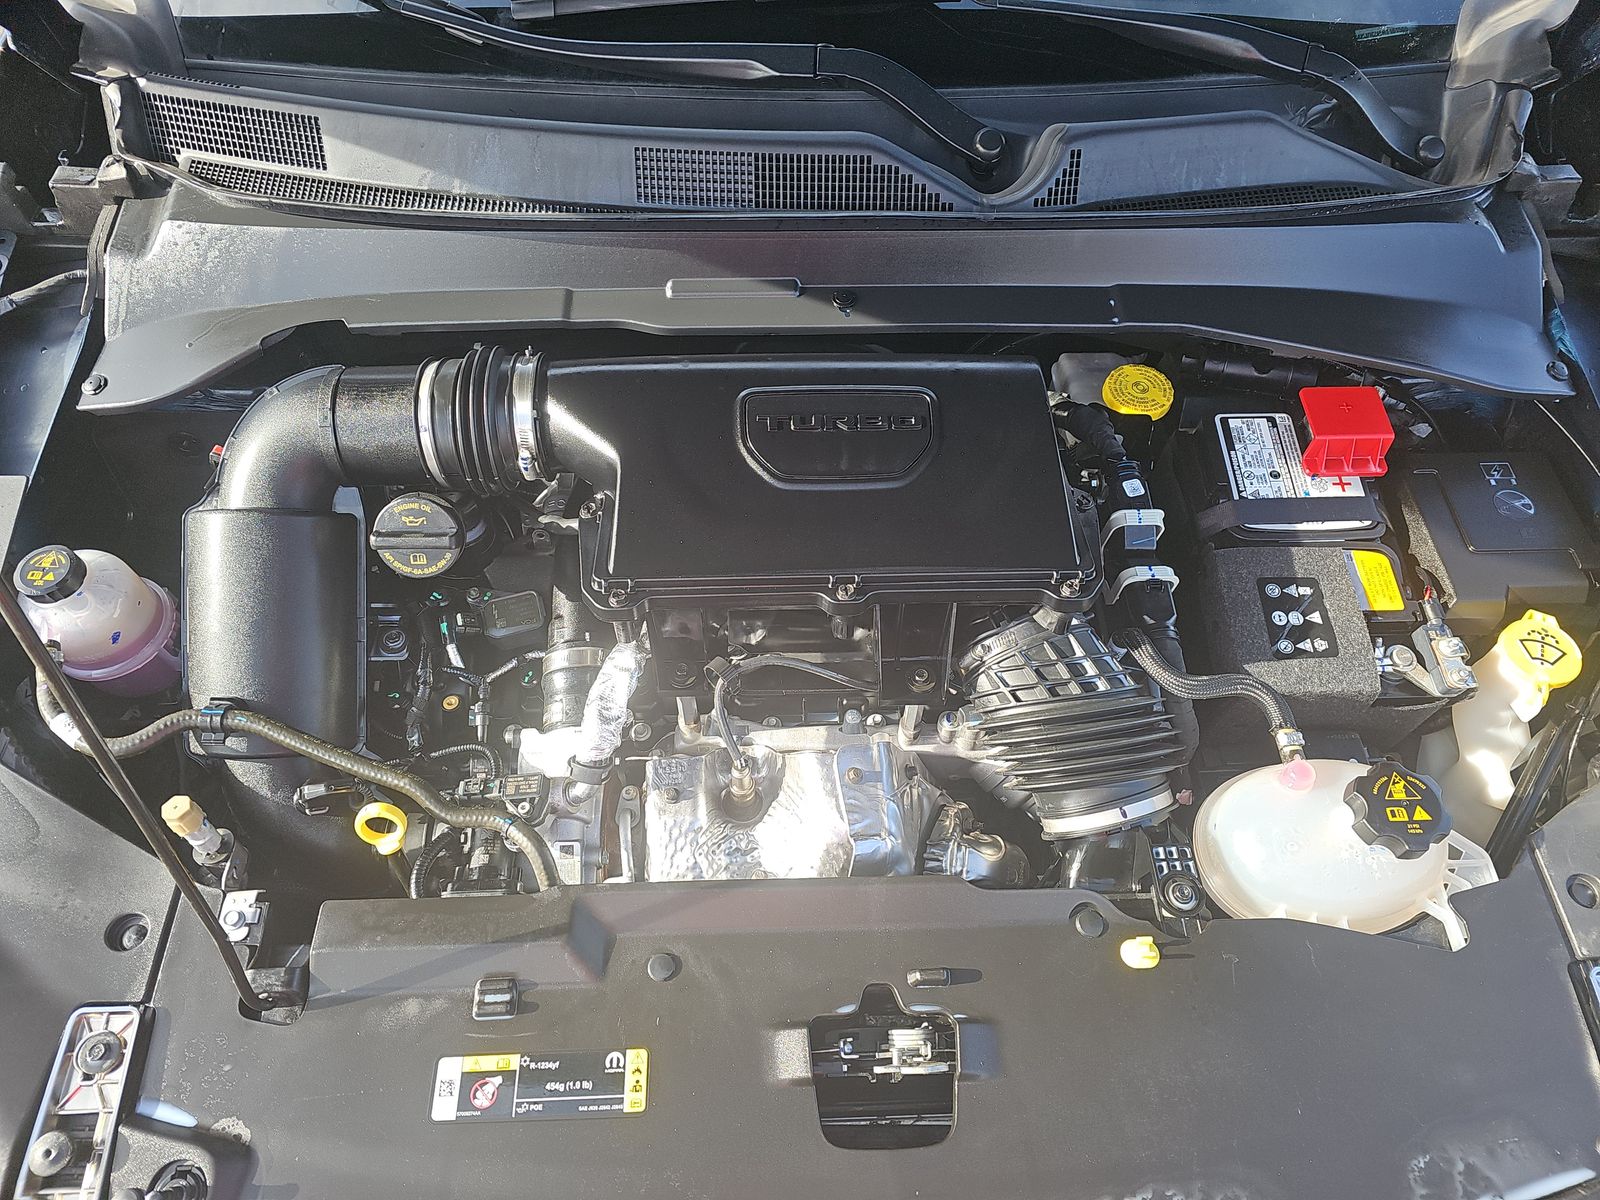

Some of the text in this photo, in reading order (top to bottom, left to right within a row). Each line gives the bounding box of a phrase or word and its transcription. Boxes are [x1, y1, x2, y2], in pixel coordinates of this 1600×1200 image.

[756, 414, 926, 432] TURBO
[393, 502, 433, 514] ENGINE OIL
[383, 552, 395, 563] API
[529, 1061, 560, 1070] R-1234yf
[544, 1080, 593, 1091] 454g (1.0 lb)
[529, 1103, 543, 1111] POE
